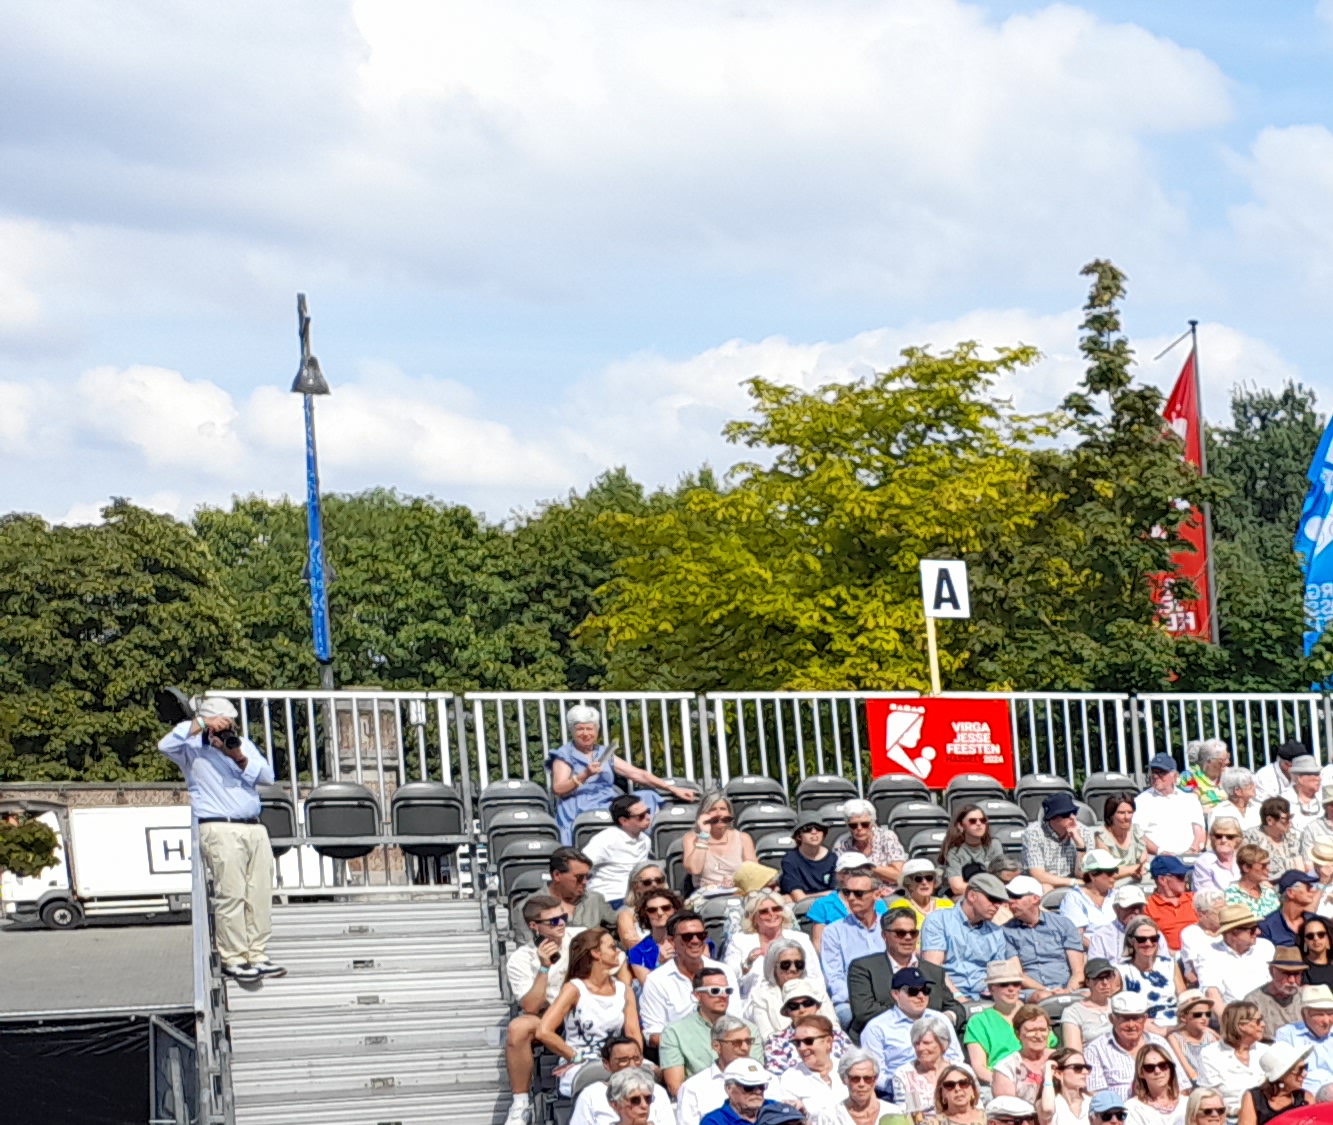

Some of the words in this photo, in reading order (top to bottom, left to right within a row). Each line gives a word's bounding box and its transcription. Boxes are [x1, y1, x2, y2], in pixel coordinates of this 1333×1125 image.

[933, 567, 961, 610] A
[951, 721, 990, 732] VIRGA
[953, 732, 991, 743] JESSE
[946, 743, 1001, 755] FEESTEN
